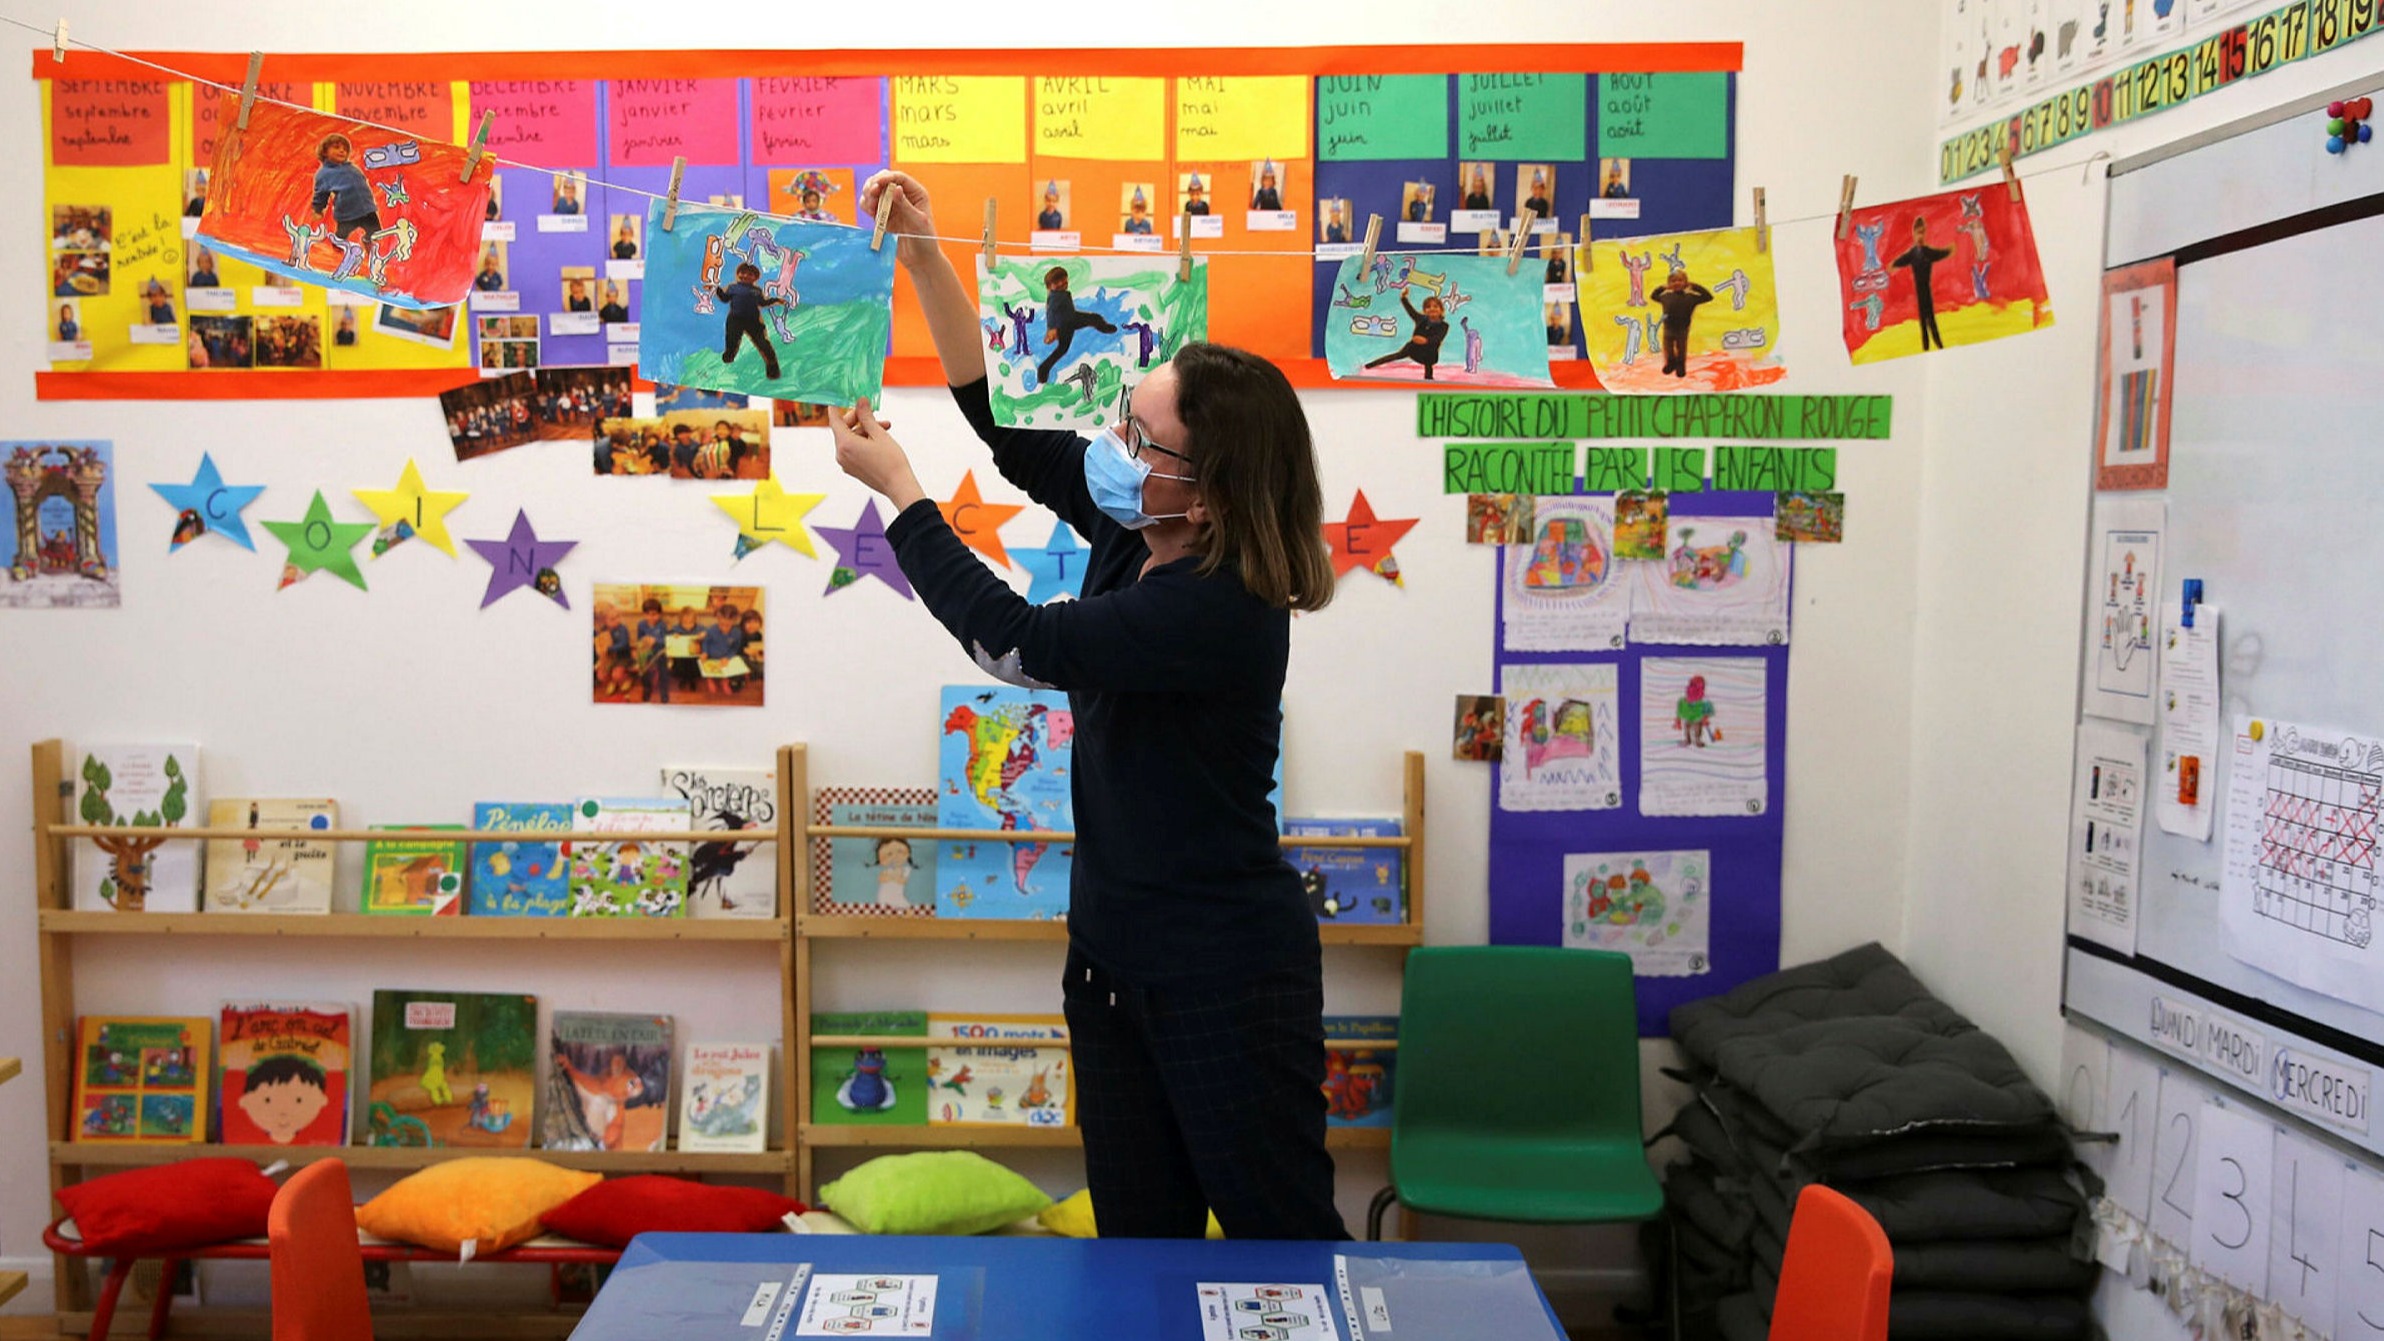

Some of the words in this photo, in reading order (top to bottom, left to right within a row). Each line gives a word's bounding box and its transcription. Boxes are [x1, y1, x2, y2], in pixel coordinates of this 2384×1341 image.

[2092, 80, 2110, 123] 10
[2114, 70, 2132, 120] 11
[2136, 61, 2159, 113] 12
[2161, 53, 2189, 105] 13
[2194, 38, 2217, 95] 14
[2220, 26, 2247, 81] 15
[2249, 15, 2276, 73] 16
[2281, 1, 2307, 60] 17
[2313, 0, 2339, 50] 18
[2344, 0, 2374, 38] 19
[341, 82, 439, 97] NOVEMBRE
[616, 79, 697, 97] JANVIER
[899, 76, 960, 94] MARS
[1043, 76, 1111, 94] AVRIL
[1185, 76, 1226, 93] MAI
[1326, 74, 1383, 94] JUIN
[1469, 73, 1545, 91] JUILLET
[620, 102, 691, 127] janvier
[900, 102, 957, 122] mars
[1042, 99, 1088, 116] avril
[1182, 100, 1219, 115] mai
[1324, 101, 1372, 125] juin
[1468, 97, 1524, 121] juillet
[1042, 118, 1084, 138] avril
[1180, 122, 1219, 137] mai
[1467, 124, 1513, 152] juillet
[901, 134, 951, 149] mars
[1327, 133, 1368, 155] juin
[1421, 395, 1529, 438] L'HISTOIRE
[1536, 397, 1569, 438] DU
[1652, 394, 1783, 438] CHAPERON
[1801, 394, 1884, 439] ROUGE
[1445, 442, 1574, 495] RACONTÉE
[1587, 448, 1650, 491] PAR
[1715, 446, 1834, 491] ENFANTS
[951, 1023, 999, 1039] 1500
[977, 1046, 1038, 1061] images
[2120, 1089, 2139, 1166] 1
[2161, 1111, 2193, 1221] 2
[2211, 1156, 2252, 1250] 3
[2290, 1158, 2320, 1297] 4
